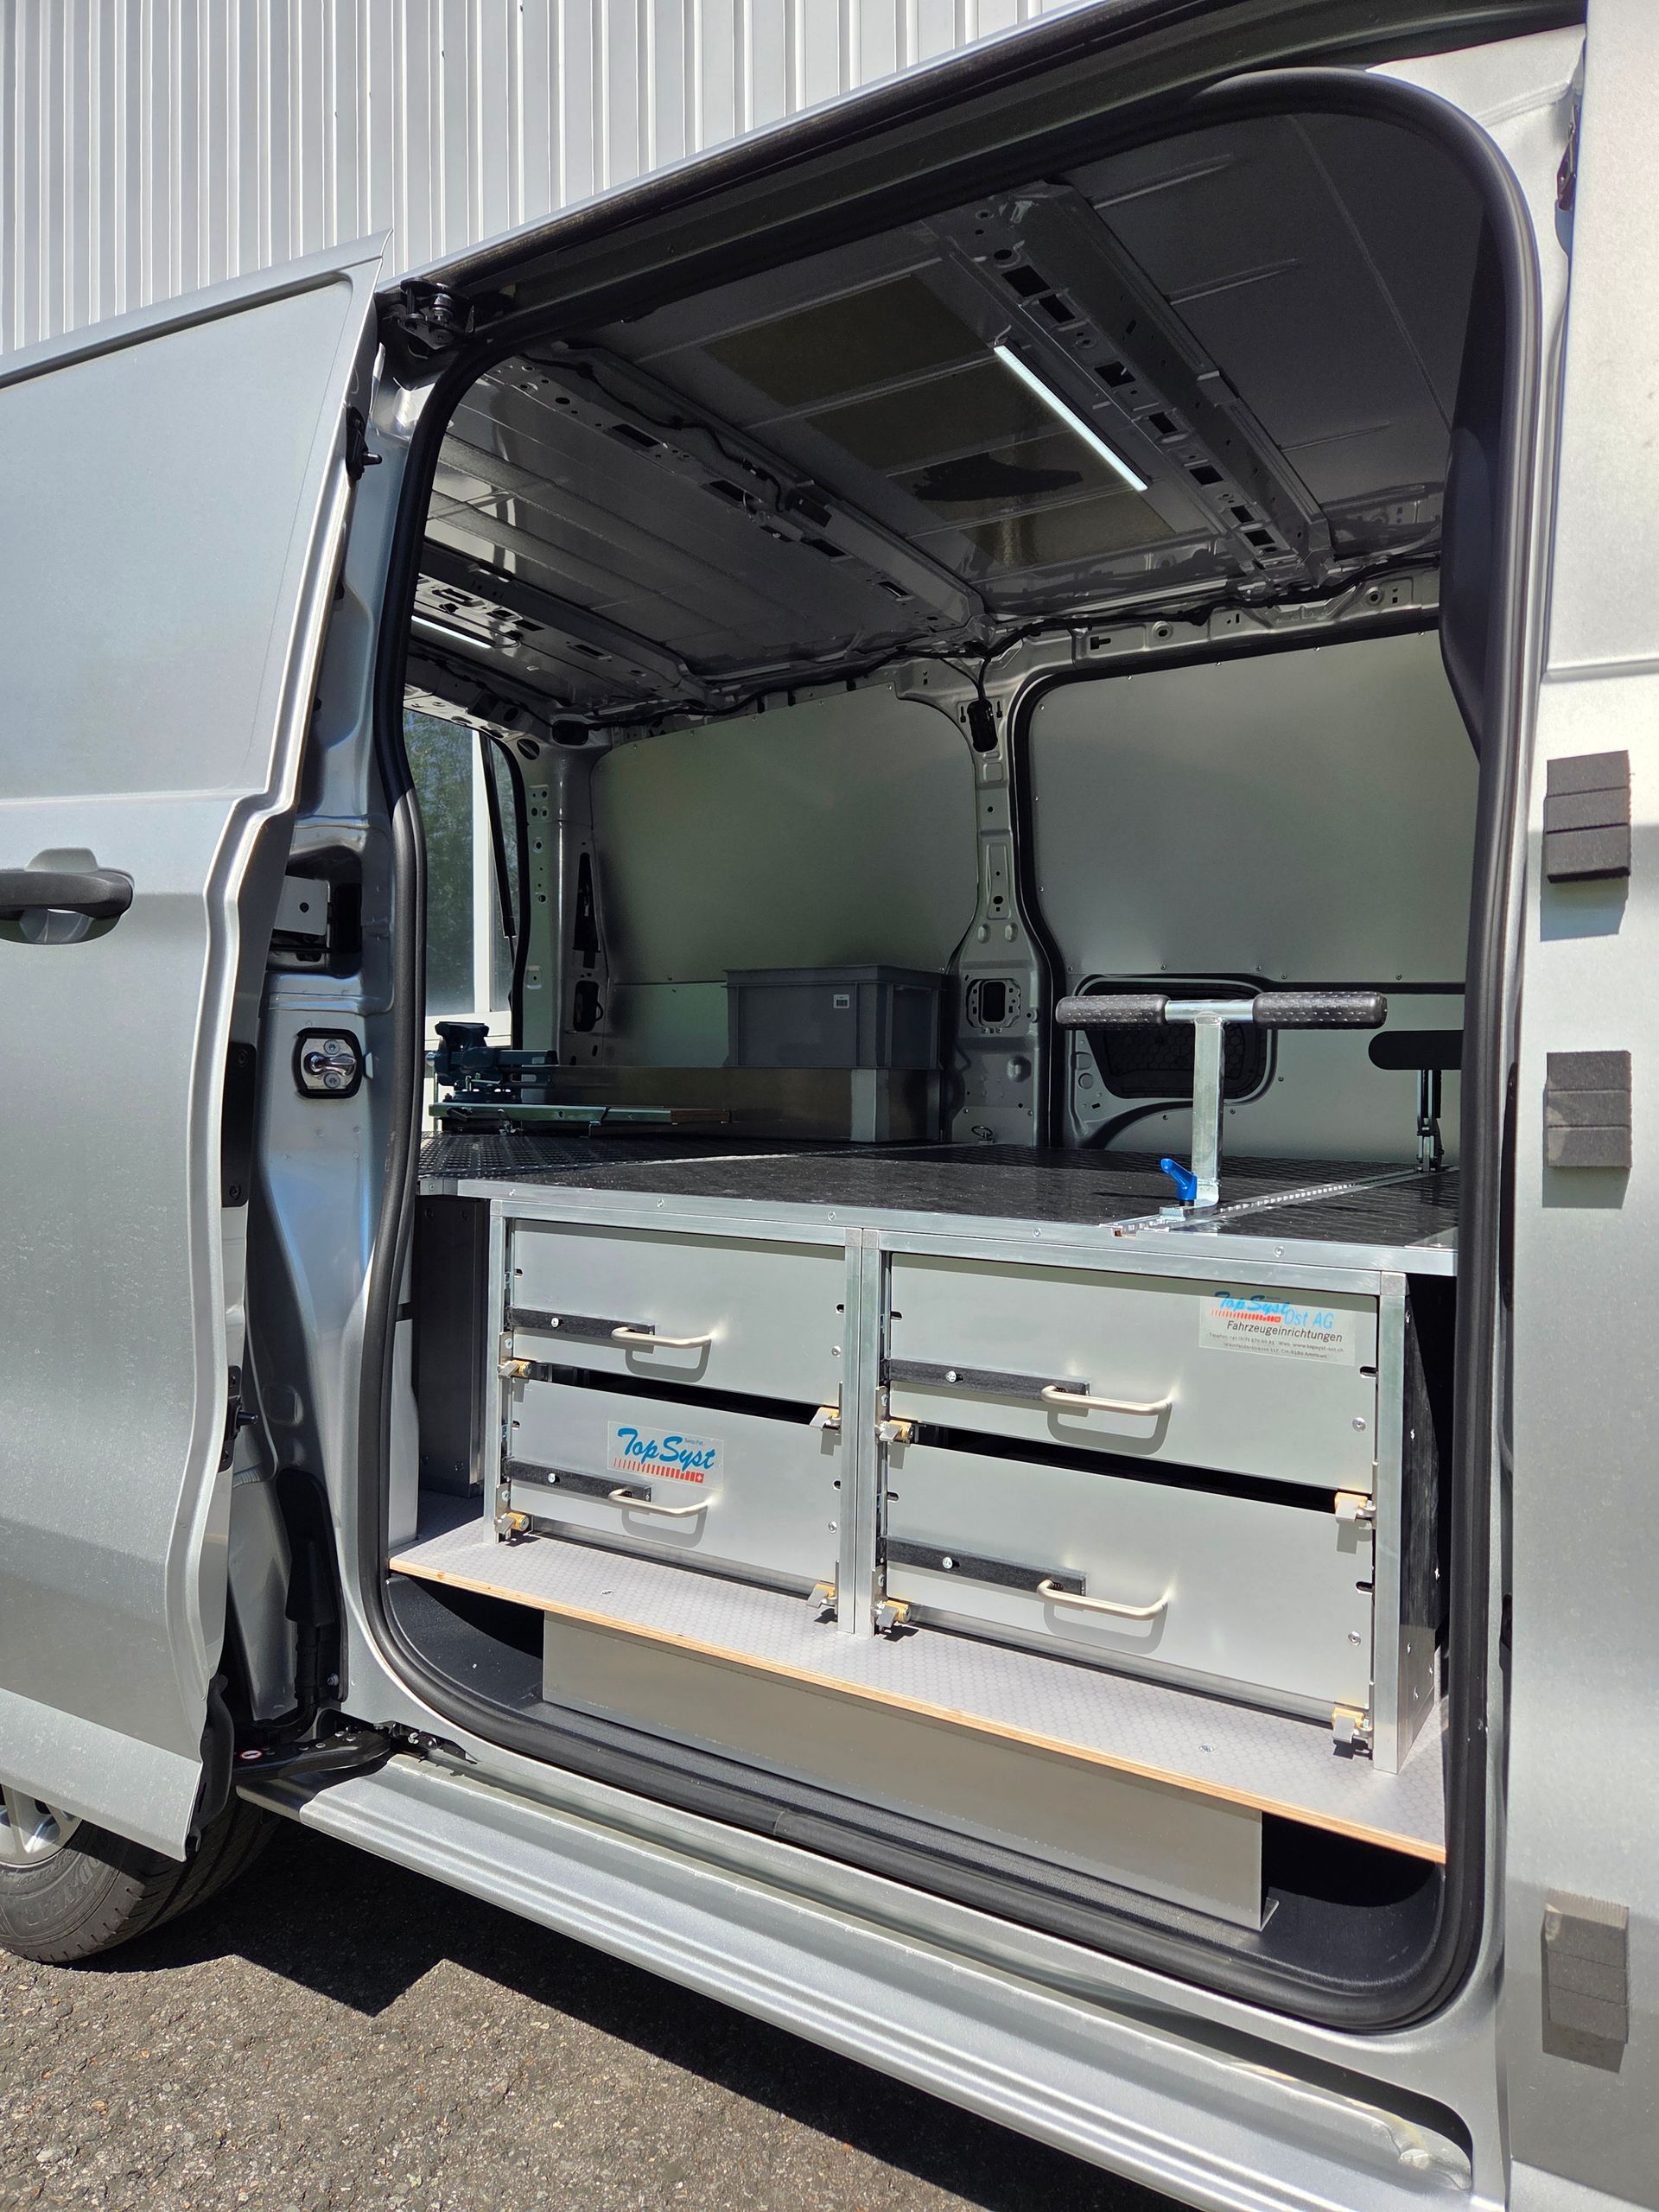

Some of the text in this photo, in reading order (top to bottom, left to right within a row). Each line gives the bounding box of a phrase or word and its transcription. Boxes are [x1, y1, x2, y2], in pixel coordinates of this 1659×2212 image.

[1284, 1309, 1309, 1326] Ost
[1313, 1312, 1335, 1329] AG
[1227, 1319, 1343, 1343] Fahrzeugeinrichtungen
